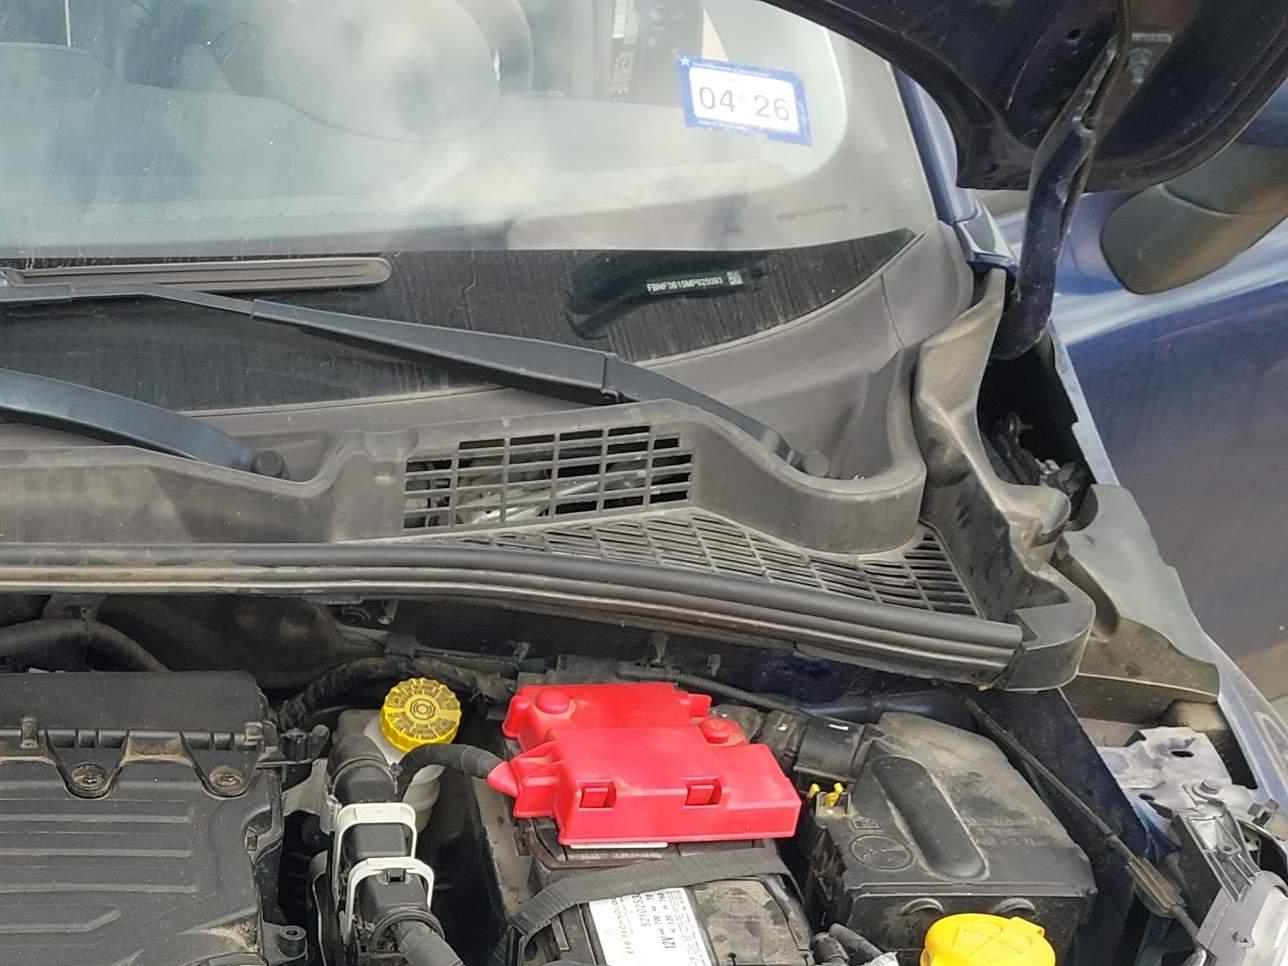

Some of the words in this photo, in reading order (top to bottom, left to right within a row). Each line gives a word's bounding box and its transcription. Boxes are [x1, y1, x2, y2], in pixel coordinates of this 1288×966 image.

[699, 86, 736, 112] 04
[754, 94, 789, 121] 26
[659, 934, 677, 949] 12V
